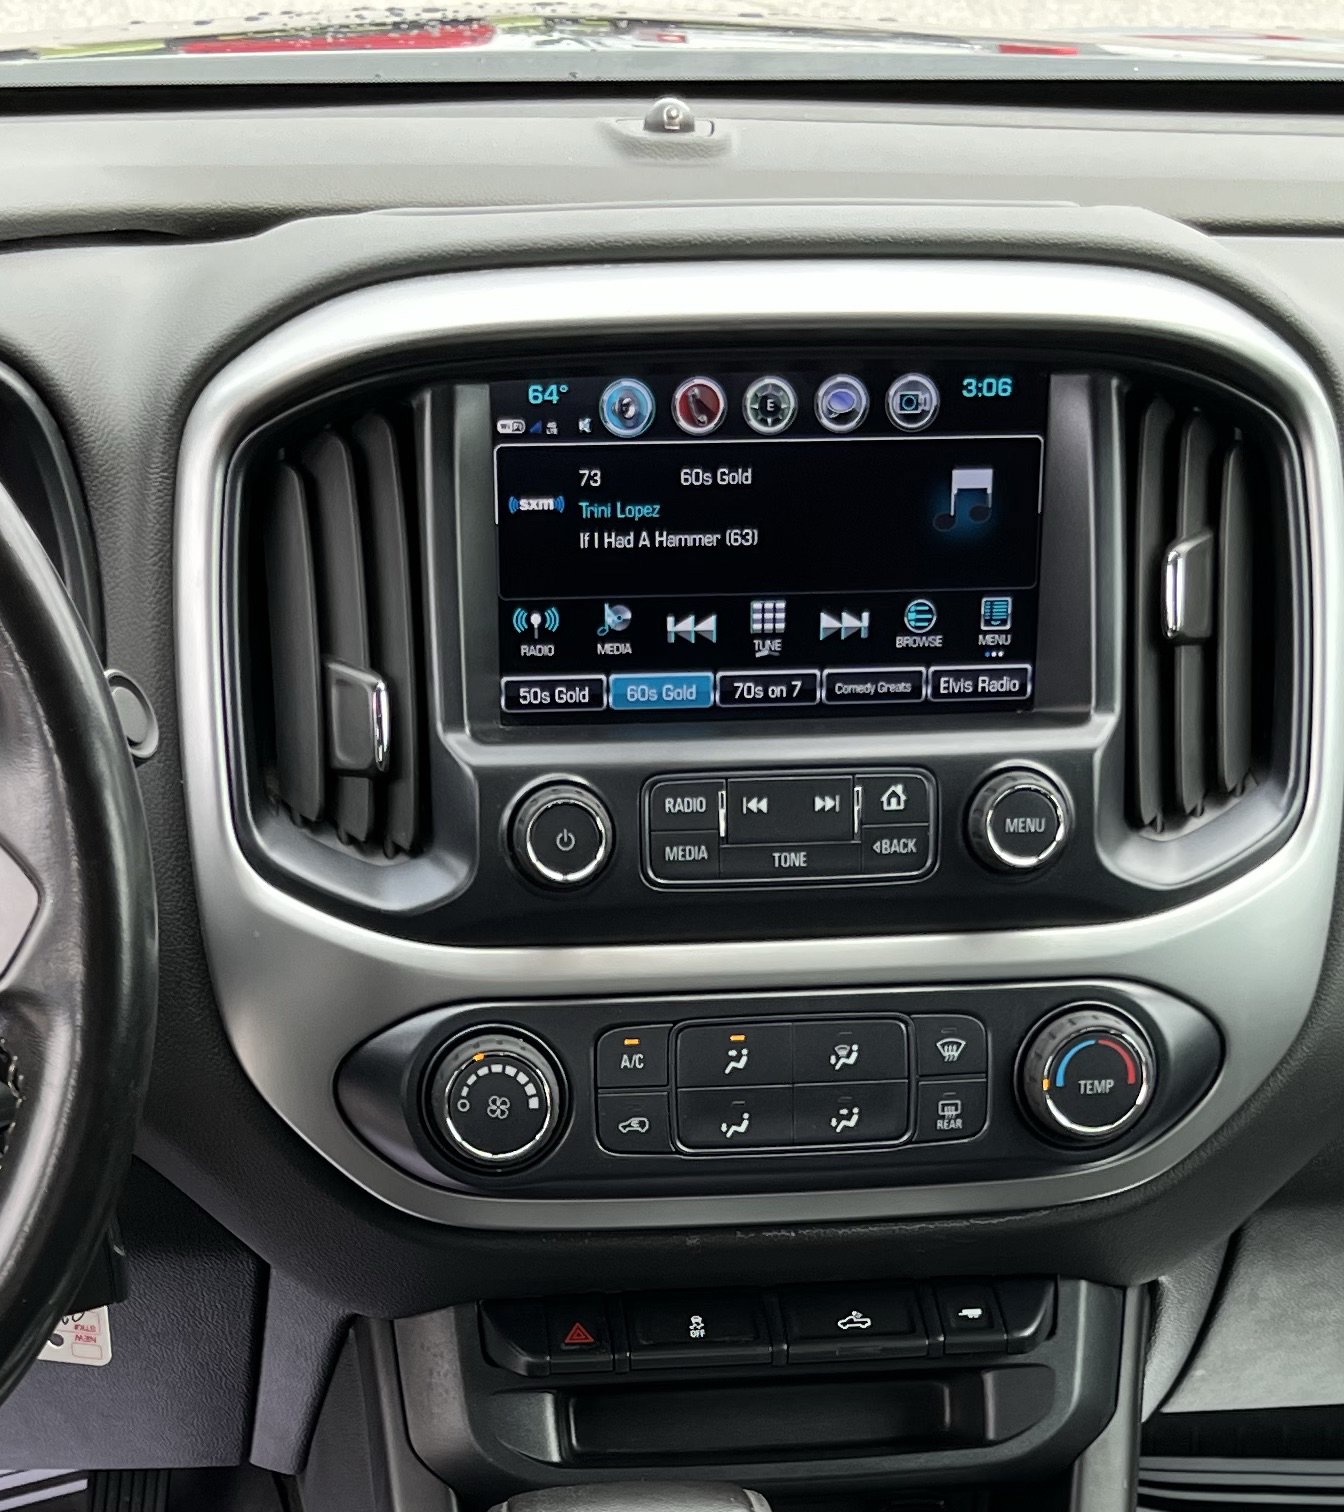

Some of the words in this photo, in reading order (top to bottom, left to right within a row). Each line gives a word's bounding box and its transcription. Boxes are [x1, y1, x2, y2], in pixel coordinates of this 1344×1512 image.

[528, 383, 569, 405] 64°
[961, 377, 1013, 398] 3:06
[578, 469, 602, 487] 73
[680, 468, 713, 486] 60s
[716, 468, 753, 486] Gold
[578, 502, 612, 519] Trini
[616, 501, 661, 521] Lopez
[579, 532, 591, 549] If
[594, 532, 599, 549] I
[604, 531, 635, 549] Had
[638, 531, 651, 548] A
[655, 530, 722, 548] Hammer
[725, 528, 759, 547] (63)
[752, 639, 783, 651] TUNE
[895, 635, 944, 648] BROWSE
[977, 633, 1012, 647] MENU
[520, 644, 555, 657] RADIO
[596, 643, 633, 656] MEDIA
[626, 685, 658, 702] 60s
[662, 684, 698, 702] Gold
[733, 682, 764, 699] 70s
[768, 684, 787, 699] on
[791, 681, 803, 698] 7
[834, 681, 875, 695] Comedy
[877, 680, 913, 694] Greats
[939, 676, 973, 694] Elvis
[978, 675, 1020, 693] Radio
[519, 688, 551, 705] 50s
[555, 687, 590, 704] Gold
[664, 797, 707, 814] RADIO
[1004, 816, 1046, 835] MENU
[664, 844, 708, 863] MEDIA
[881, 837, 917, 855] BACK
[772, 851, 808, 869] TONE
[620, 1051, 646, 1072] A/C
[1077, 1077, 1116, 1098] TEMP
[936, 1116, 964, 1132] REAR
[690, 1329, 706, 1338] OFF
